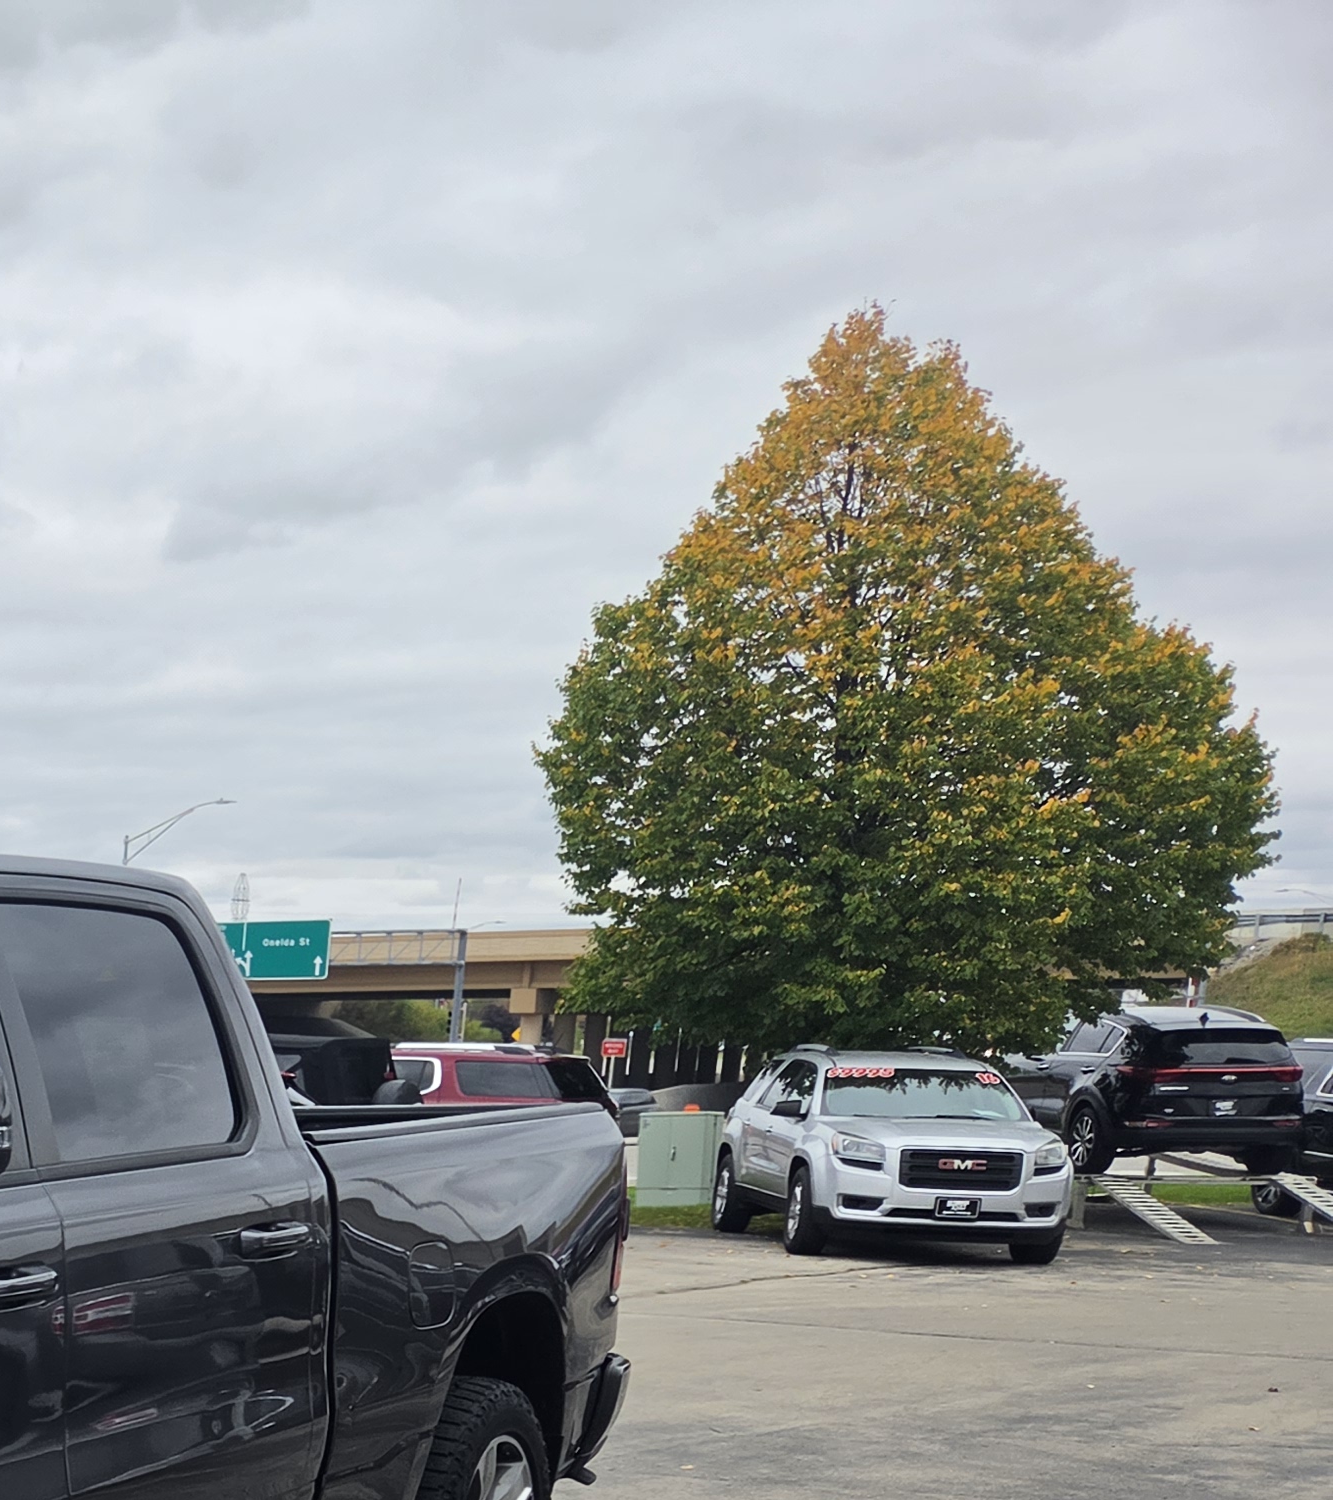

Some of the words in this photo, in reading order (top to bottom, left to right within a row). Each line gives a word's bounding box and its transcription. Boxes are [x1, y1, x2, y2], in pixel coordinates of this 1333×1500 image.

[262, 938, 295, 948] Oneida
[298, 937, 311, 947] St
[938, 1158, 988, 1171] GMC
